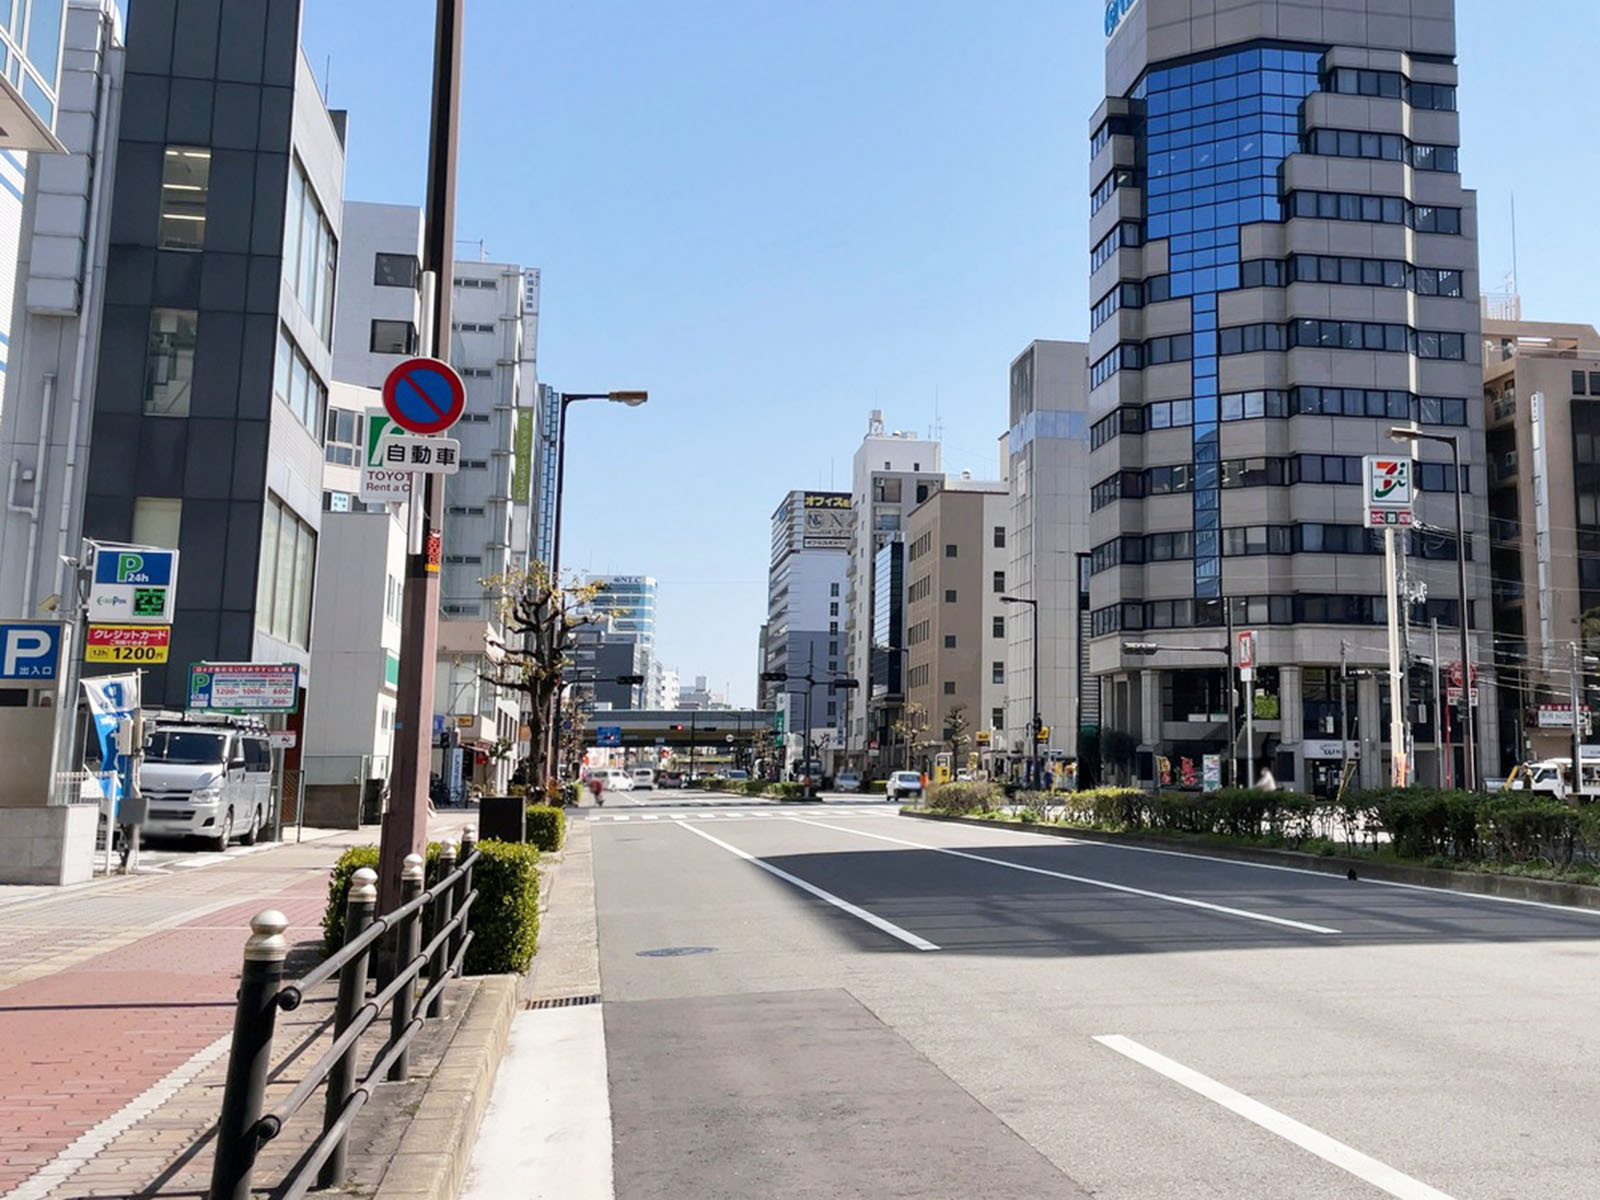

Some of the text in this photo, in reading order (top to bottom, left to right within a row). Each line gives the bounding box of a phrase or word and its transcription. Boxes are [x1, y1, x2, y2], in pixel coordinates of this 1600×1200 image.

[387, 444, 456, 466] 自動車
[367, 470, 413, 481] TOYOT
[366, 482, 390, 491] Rent
[117, 553, 144, 582] P
[127, 573, 149, 582] 24h
[94, 630, 167, 640] クレジットカード
[3, 630, 52, 675] P
[19, 666, 52, 675] 出入口
[191, 673, 210, 695] P
